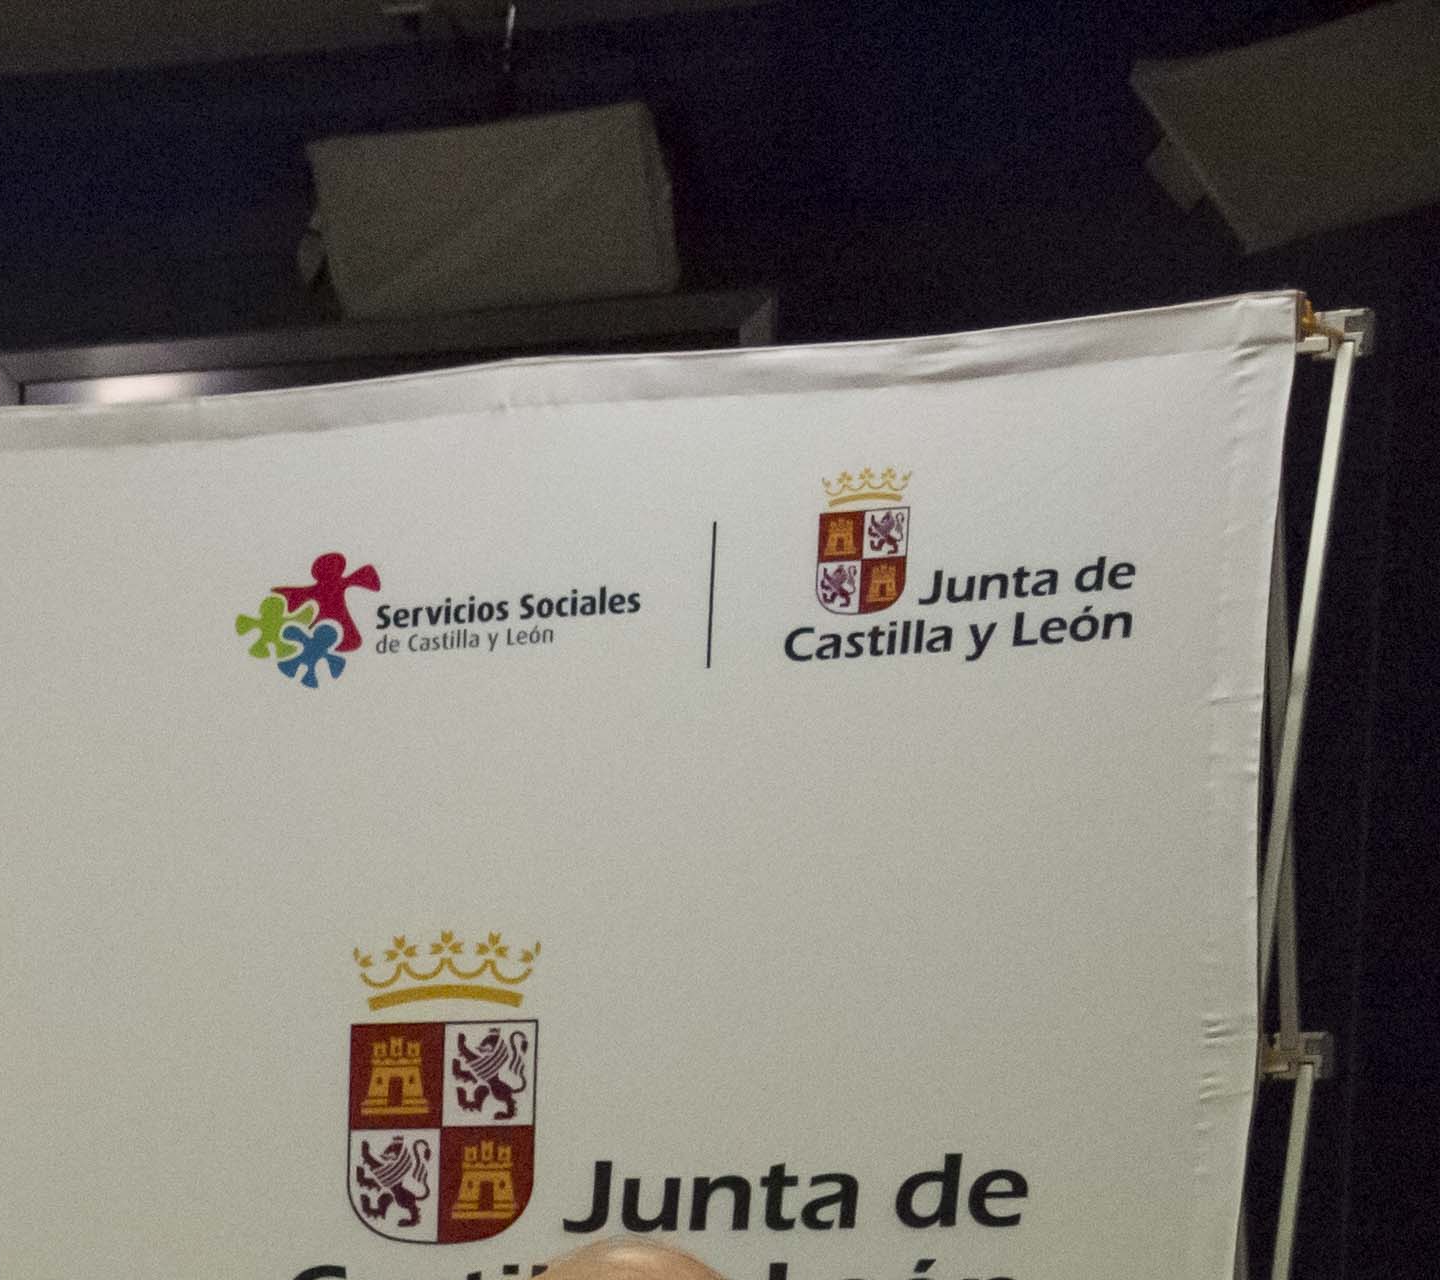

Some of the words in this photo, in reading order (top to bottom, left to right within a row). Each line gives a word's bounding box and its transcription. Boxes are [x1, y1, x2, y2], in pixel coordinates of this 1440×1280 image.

[918, 566, 1059, 606] Junta
[1074, 555, 1137, 593] de
[375, 595, 512, 630] Servicios
[519, 585, 641, 621] Sociales
[374, 633, 401, 655] de
[407, 628, 481, 653] Castilla
[487, 632, 499, 653] y
[505, 625, 555, 647] León
[783, 619, 954, 662] Castilla
[965, 622, 998, 662] y
[1012, 605, 1133, 647] León
[562, 1160, 860, 1235] Junta
[894, 1152, 1029, 1230] de
